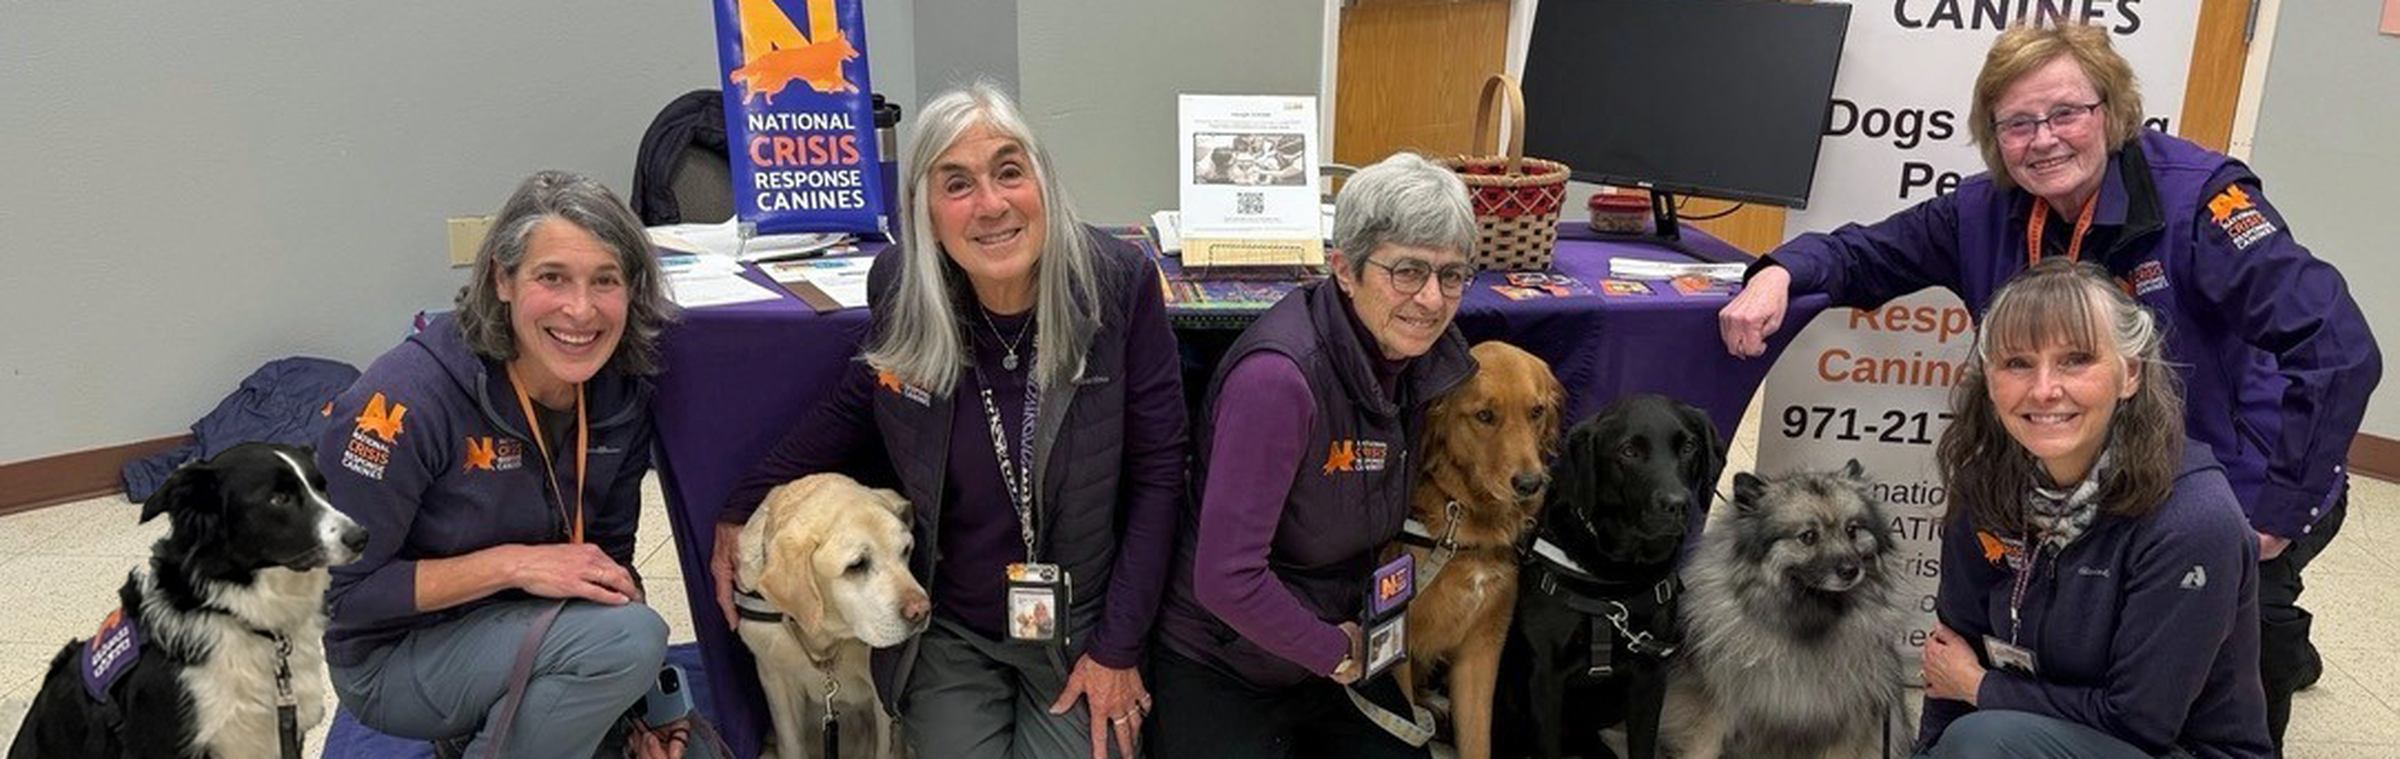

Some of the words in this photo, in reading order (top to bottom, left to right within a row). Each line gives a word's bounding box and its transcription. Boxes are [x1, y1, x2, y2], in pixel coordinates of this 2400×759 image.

[748, 113, 855, 131] NATIONAL
[1821, 99, 1955, 149] Dogs
[750, 135, 860, 167] CRISIS
[754, 170, 862, 189] RESPONSE
[757, 190, 865, 211] CANINES
[1892, 516, 1945, 542] ATI
